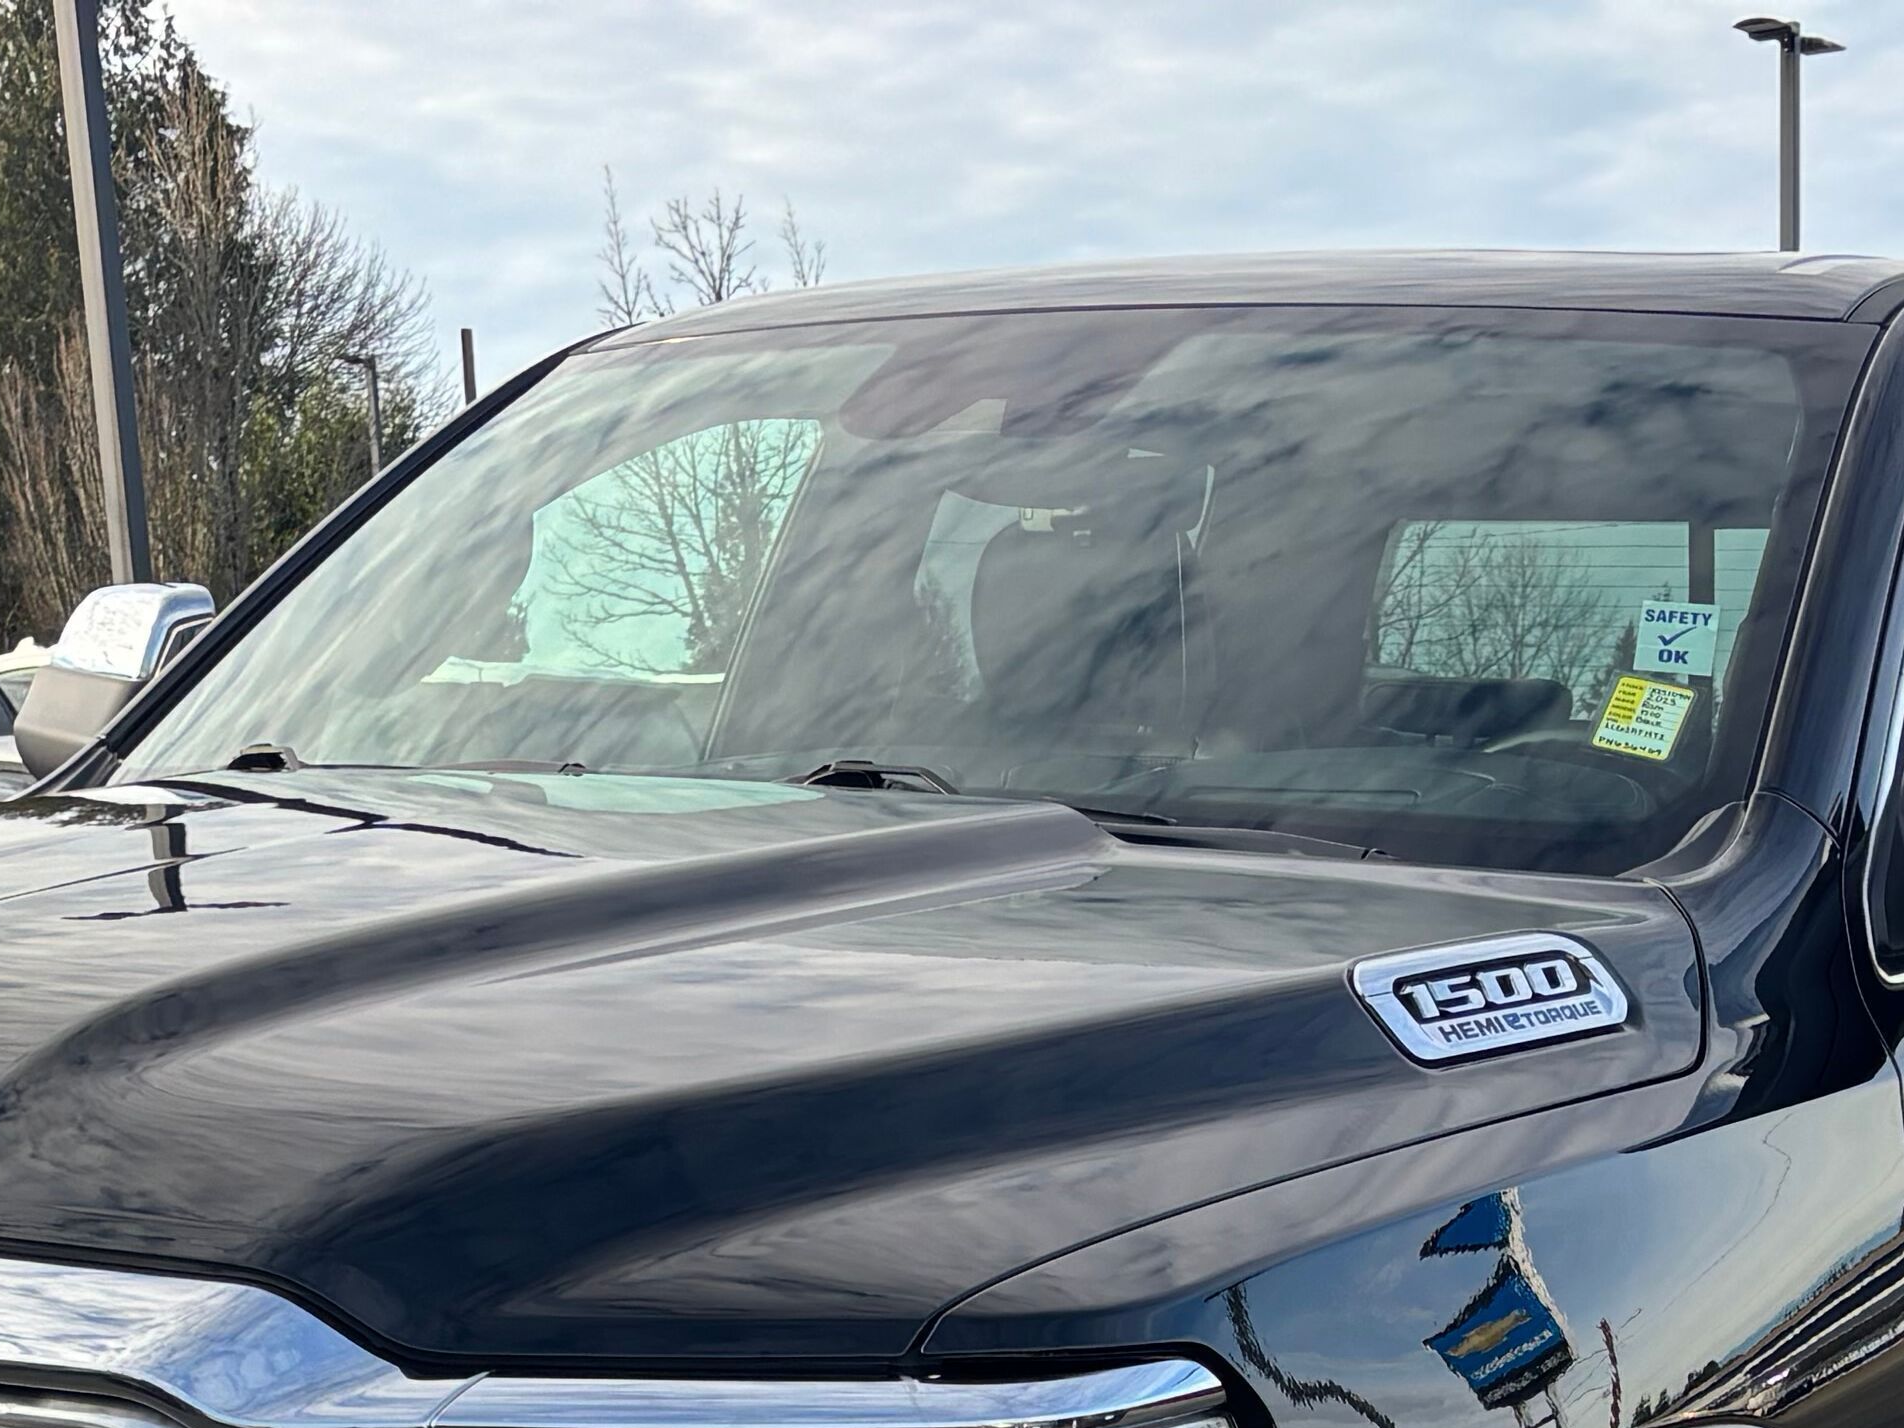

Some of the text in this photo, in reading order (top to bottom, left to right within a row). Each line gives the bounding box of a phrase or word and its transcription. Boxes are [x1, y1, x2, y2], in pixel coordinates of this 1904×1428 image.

[1644, 608, 1713, 627] SAFETY
[1658, 649, 1689, 664] OK
[1399, 958, 1578, 1019] 1500
[1438, 1017, 1507, 1044] HEMI
